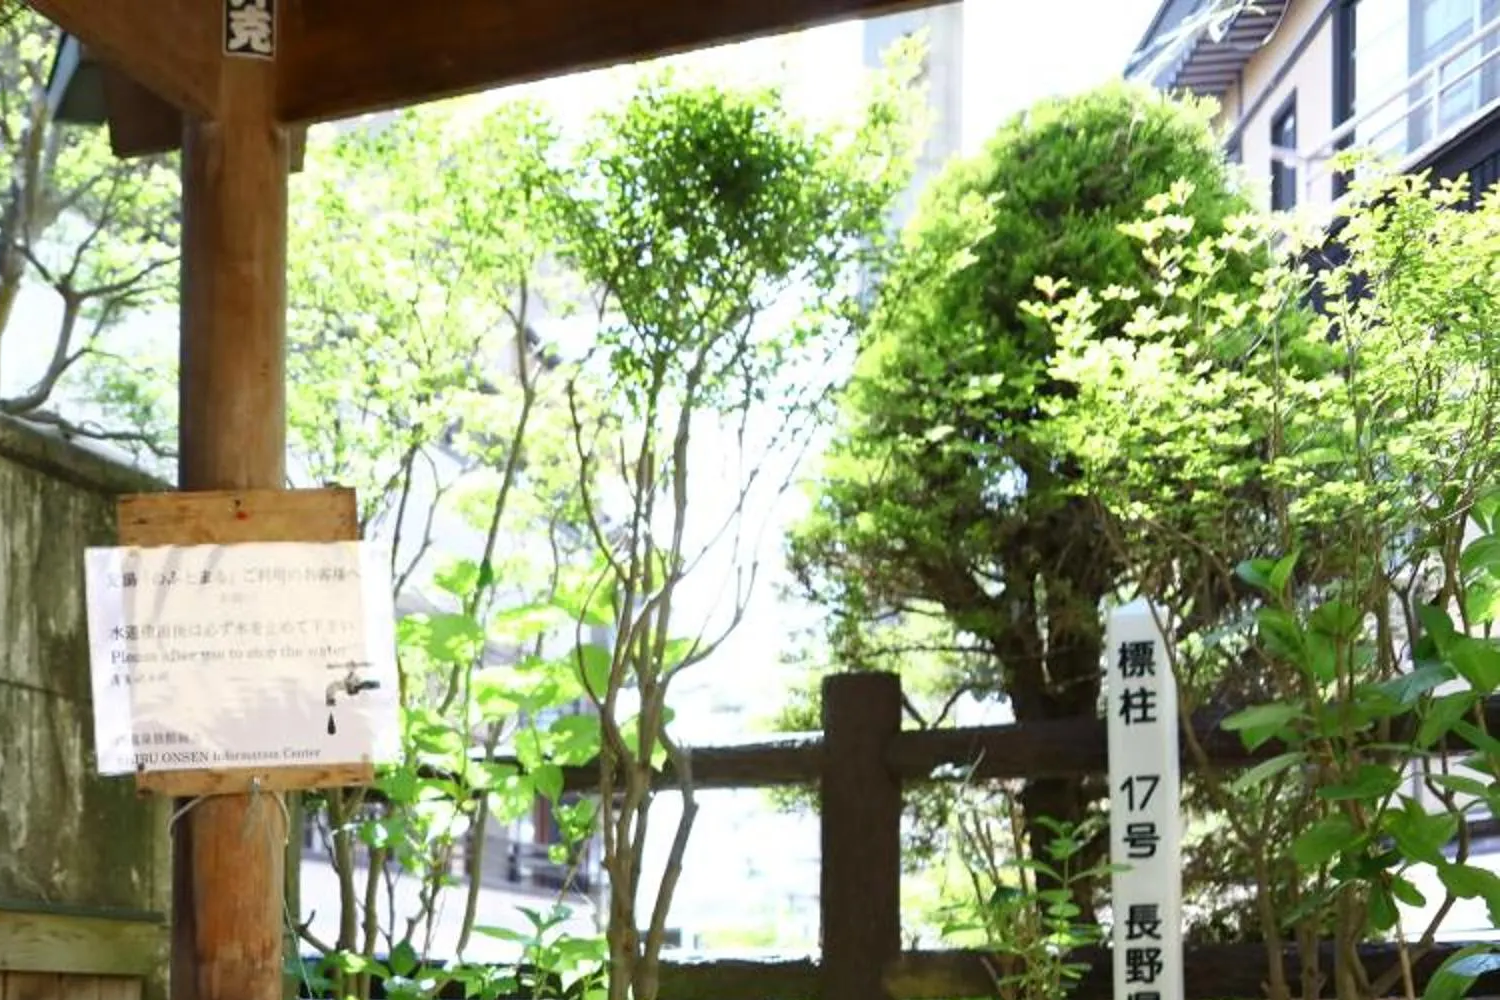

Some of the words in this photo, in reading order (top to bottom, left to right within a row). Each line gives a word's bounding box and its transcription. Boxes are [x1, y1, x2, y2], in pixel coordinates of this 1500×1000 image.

[1116, 640, 1157, 724] 標柱
[161, 751, 209, 764] ONSEN
[283, 747, 321, 759] Center
[1120, 775, 1161, 859] 17号
